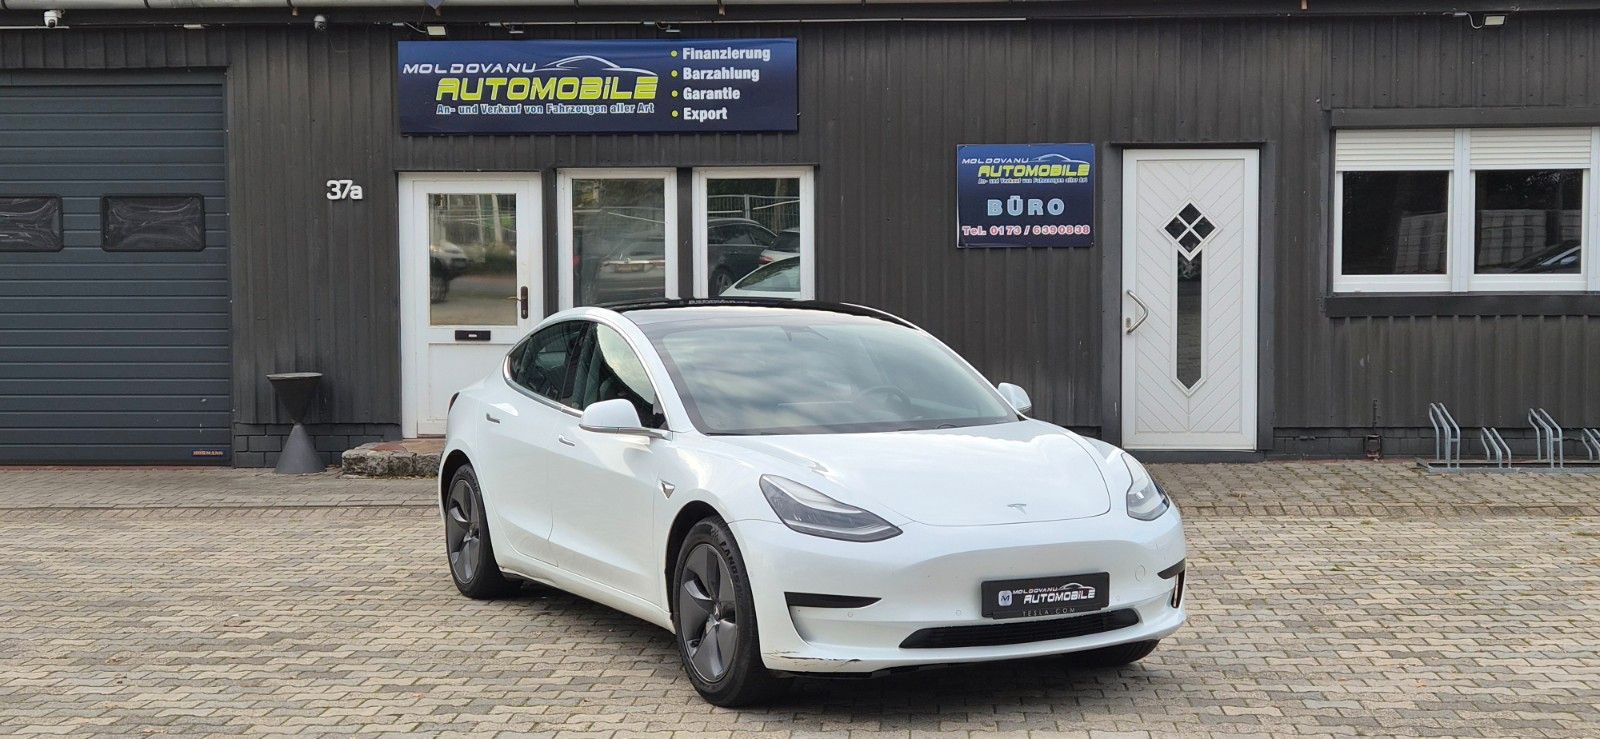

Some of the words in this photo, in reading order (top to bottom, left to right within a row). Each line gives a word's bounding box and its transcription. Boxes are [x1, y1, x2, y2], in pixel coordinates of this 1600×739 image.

[682, 47, 771, 62] Finanzierung
[403, 62, 537, 74] MOLDOVANU
[682, 67, 760, 82] Barzahlung
[683, 86, 741, 100] Garantie
[436, 104, 456, 114] An-
[458, 104, 479, 114] und
[480, 104, 522, 114] Verkauf
[524, 105, 544, 114] von
[545, 103, 608, 115] Fahrzeugen
[610, 102, 636, 113] aller
[637, 102, 655, 113] Art
[683, 106, 728, 122] Export
[326, 179, 363, 200] 37a
[987, 195, 1065, 216] BÜRO
[962, 225, 987, 236] Tel.
[990, 225, 1022, 236] 0173
[1024, 225, 1031, 236] /
[1032, 224, 1091, 236] 6390838
